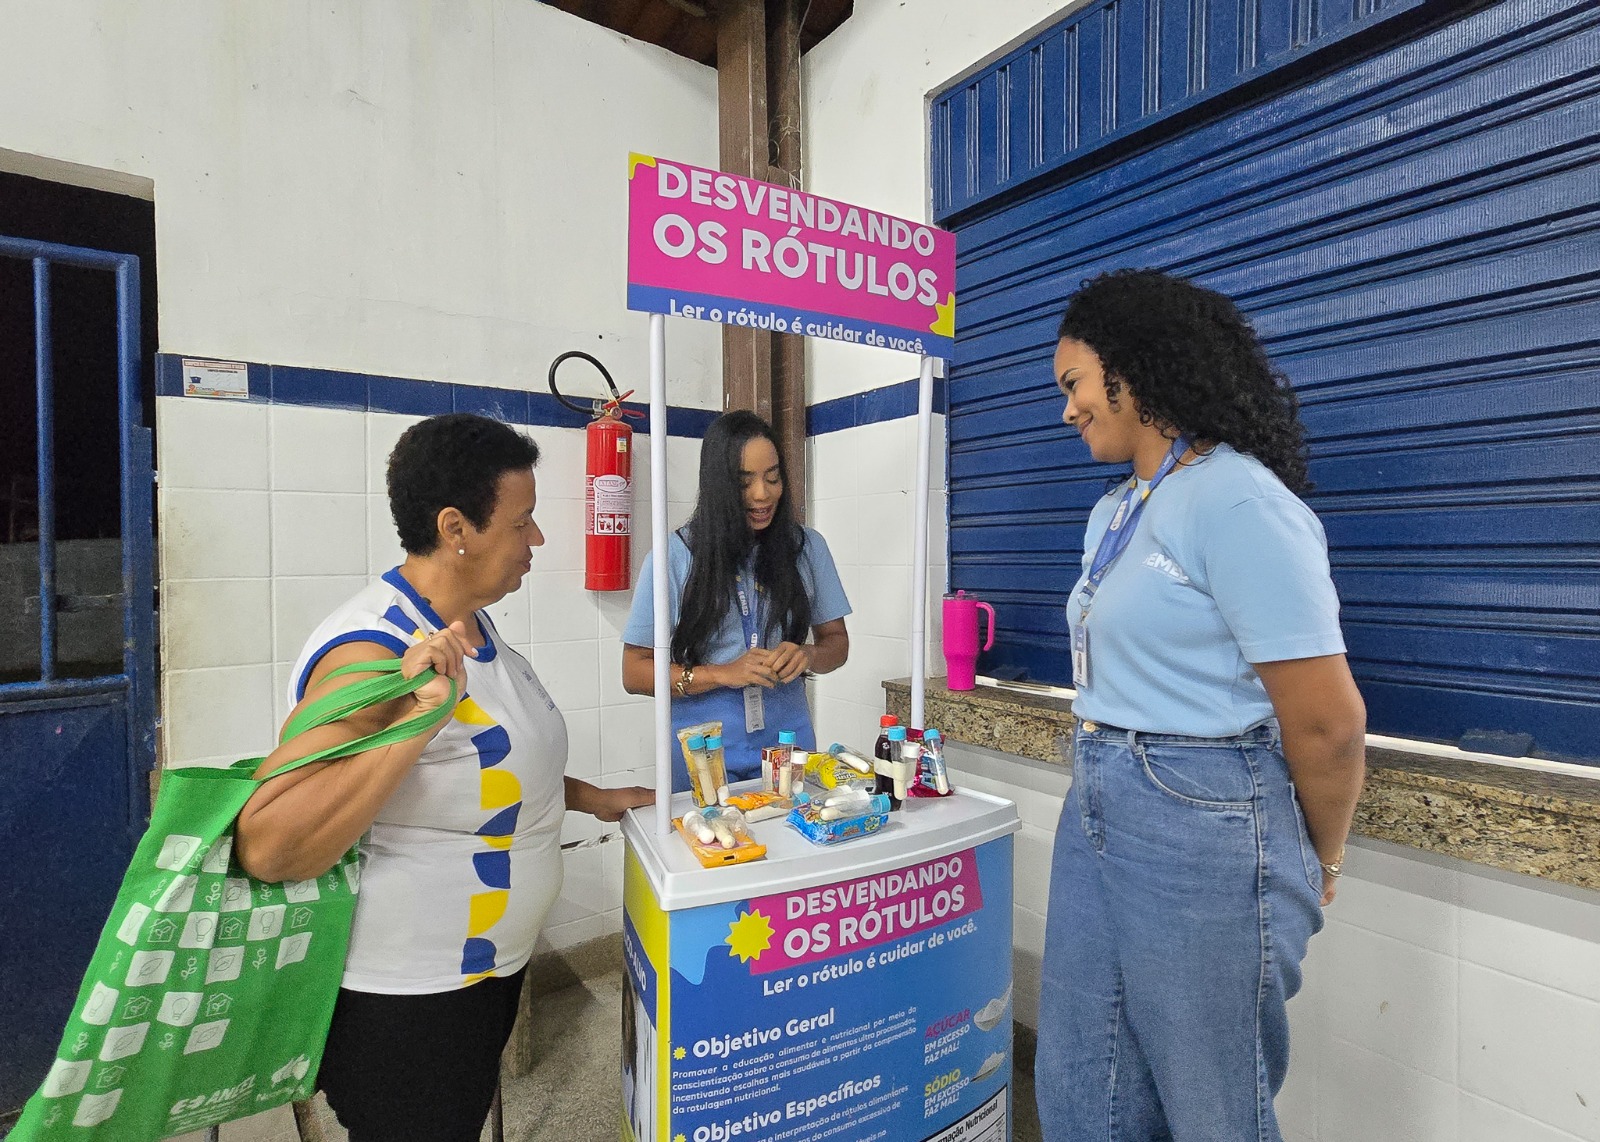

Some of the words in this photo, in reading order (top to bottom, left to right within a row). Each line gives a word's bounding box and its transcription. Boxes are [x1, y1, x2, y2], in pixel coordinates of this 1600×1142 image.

[657, 162, 936, 257] DESVENDANDO
[652, 213, 728, 264] OS
[742, 227, 938, 307] RÓTULOS
[669, 298, 705, 320] Ler
[709, 308, 723, 323] o
[727, 303, 788, 332] rótulo
[791, 316, 803, 333] é
[806, 321, 862, 344] cuidar
[865, 329, 886, 348] de
[888, 336, 927, 356] você.
[786, 857, 963, 920] DESVENDANDO
[783, 922, 831, 959] OS
[839, 884, 965, 947] RÓTULOS
[763, 977, 793, 997] Ler
[797, 974, 809, 988] o
[812, 958, 864, 985] rótulo
[866, 953, 876, 969] é
[879, 937, 925, 965] cuidar
[928, 932, 944, 949] de
[947, 918, 978, 941] você.
[672, 1066, 718, 1079] Promover
[733, 1052, 775, 1069] educação
[778, 1040, 818, 1057] alimentar
[830, 1022, 871, 1041] nutricional
[873, 1017, 886, 1028] por
[888, 1010, 905, 1022] meio
[692, 1027, 782, 1059] Objetivo
[785, 1007, 835, 1036] Geral
[924, 1040, 937, 1054] EM
[937, 1023, 971, 1048] EXCESSO
[925, 1008, 971, 1040] AÇÚCAR
[672, 1072, 744, 1091] conscientização
[744, 1066, 767, 1078] sobre
[775, 1052, 810, 1069] consumo
[811, 1049, 821, 1058] de
[821, 1039, 858, 1055] alimentos
[858, 1032, 875, 1043] ultra
[672, 1087, 731, 1103] incentivando
[733, 1076, 769, 1092] escolhas
[771, 1069, 791, 1081] mais
[792, 1056, 831, 1075] saudáveis
[840, 1046, 861, 1061] partir
[862, 1043, 872, 1052] da
[873, 1027, 917, 1048] compreensão
[924, 1052, 940, 1066] FAZ
[940, 1040, 960, 1058] MAL!
[672, 1106, 685, 1115] da
[686, 1098, 733, 1114] rotulagem
[734, 1083, 781, 1103] nutricional.
[692, 1111, 782, 1142] Objetivo
[785, 1074, 881, 1120] Específicos
[924, 1068, 961, 1097] SÓDIO
[924, 1095, 937, 1109] EM
[937, 1077, 970, 1102] EXCESSO
[924, 1105, 940, 1119] FAZ
[940, 1092, 960, 1112] MAL!
[774, 1116, 830, 1141] interpretação
[830, 1112, 841, 1121] de
[841, 1101, 868, 1117] rótulos
[868, 1084, 909, 1107] alimentares
[811, 1131, 822, 1141] do
[823, 1119, 857, 1137] consumo
[858, 1105, 891, 1124] excessivo
[891, 1100, 901, 1109] de
[965, 1099, 998, 1129] Nutricional
